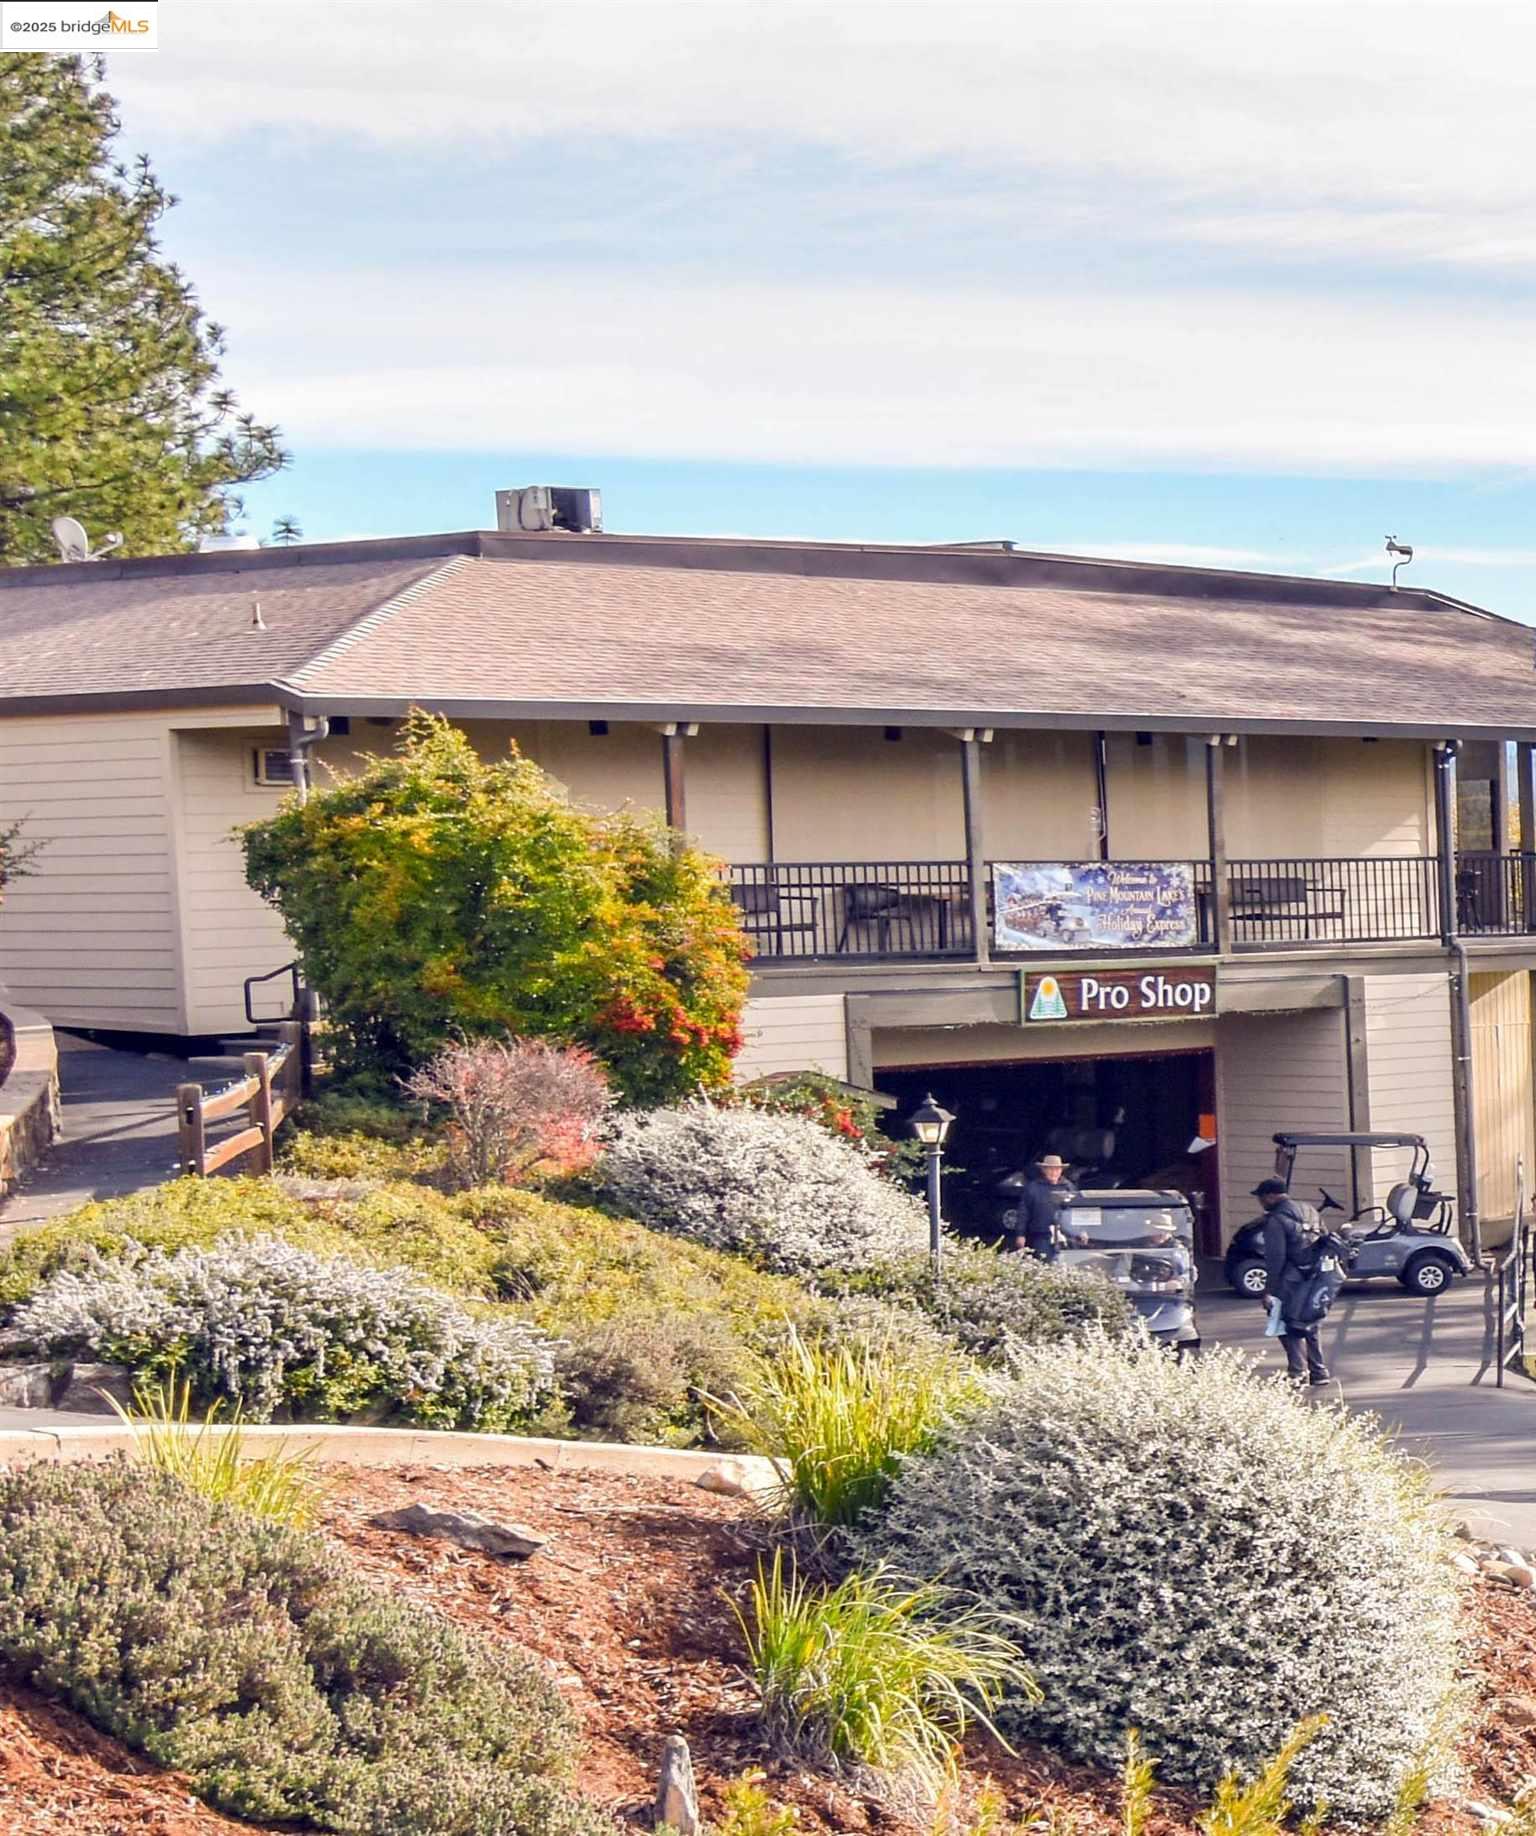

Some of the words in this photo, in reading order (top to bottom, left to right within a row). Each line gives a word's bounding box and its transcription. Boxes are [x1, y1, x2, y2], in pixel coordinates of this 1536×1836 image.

[1097, 912, 1143, 939] Holiday
[1081, 978, 1129, 1011] Pro
[1140, 975, 1211, 1012] Shop
